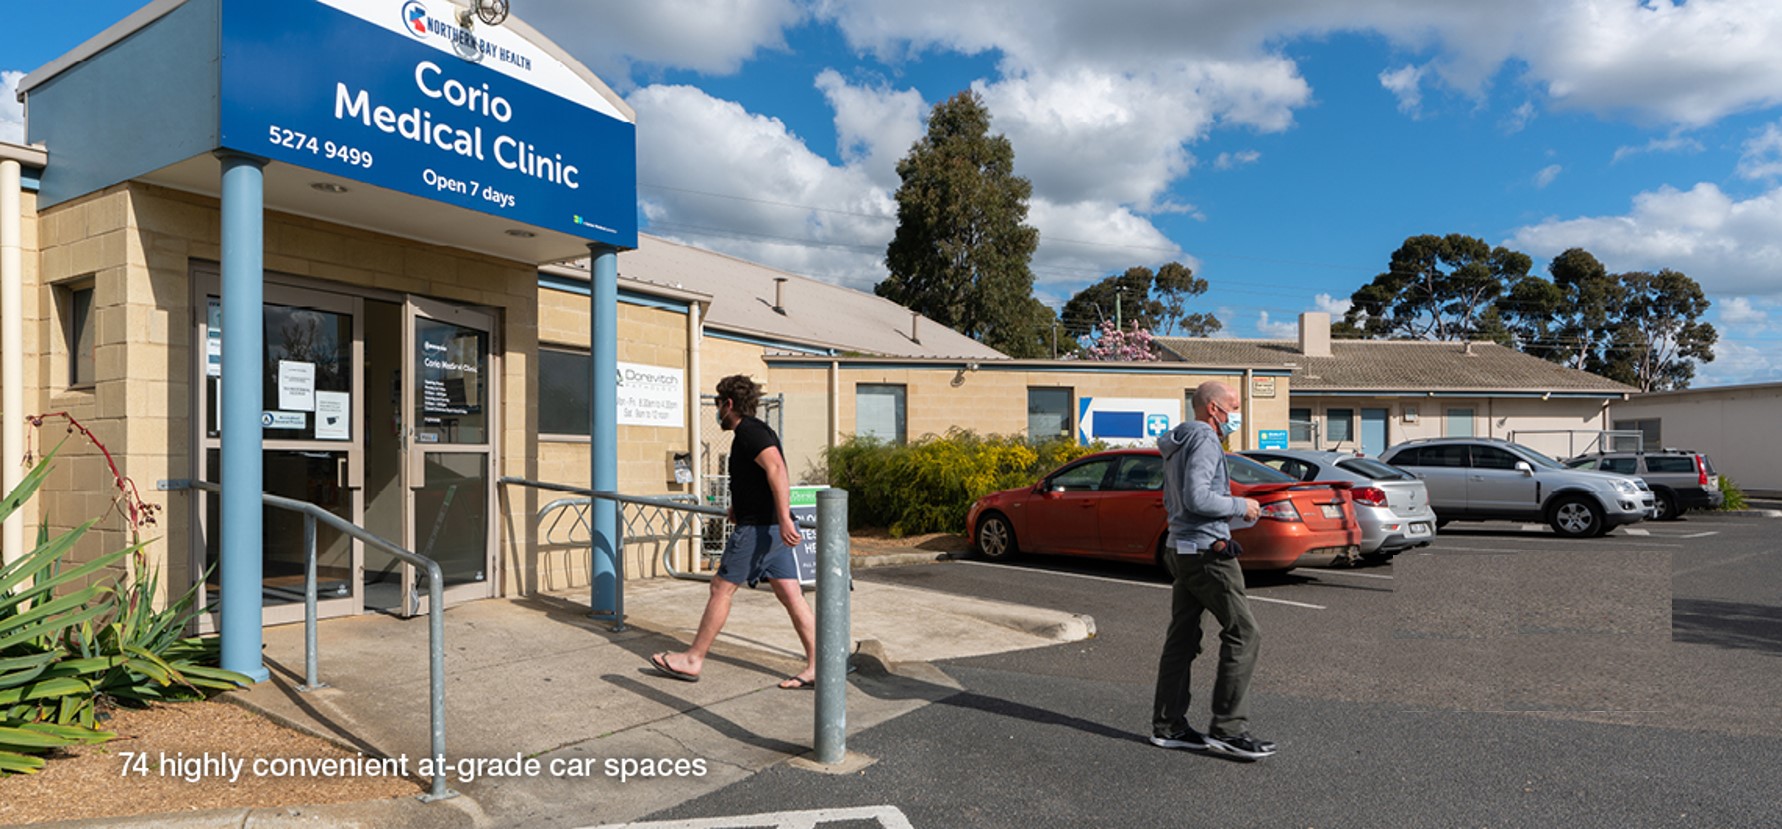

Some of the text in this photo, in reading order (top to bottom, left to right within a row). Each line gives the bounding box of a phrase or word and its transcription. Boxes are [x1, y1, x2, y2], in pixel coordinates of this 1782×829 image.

[426, 16, 532, 71] NORTHERN BAY HEALTH
[415, 61, 512, 123] Corio
[269, 125, 373, 169] 5274 9499
[334, 81, 580, 189] Medical Clinic
[422, 168, 516, 208] Open 7 days
[424, 357, 441, 369] Corio
[625, 369, 679, 384] Dorevitch
